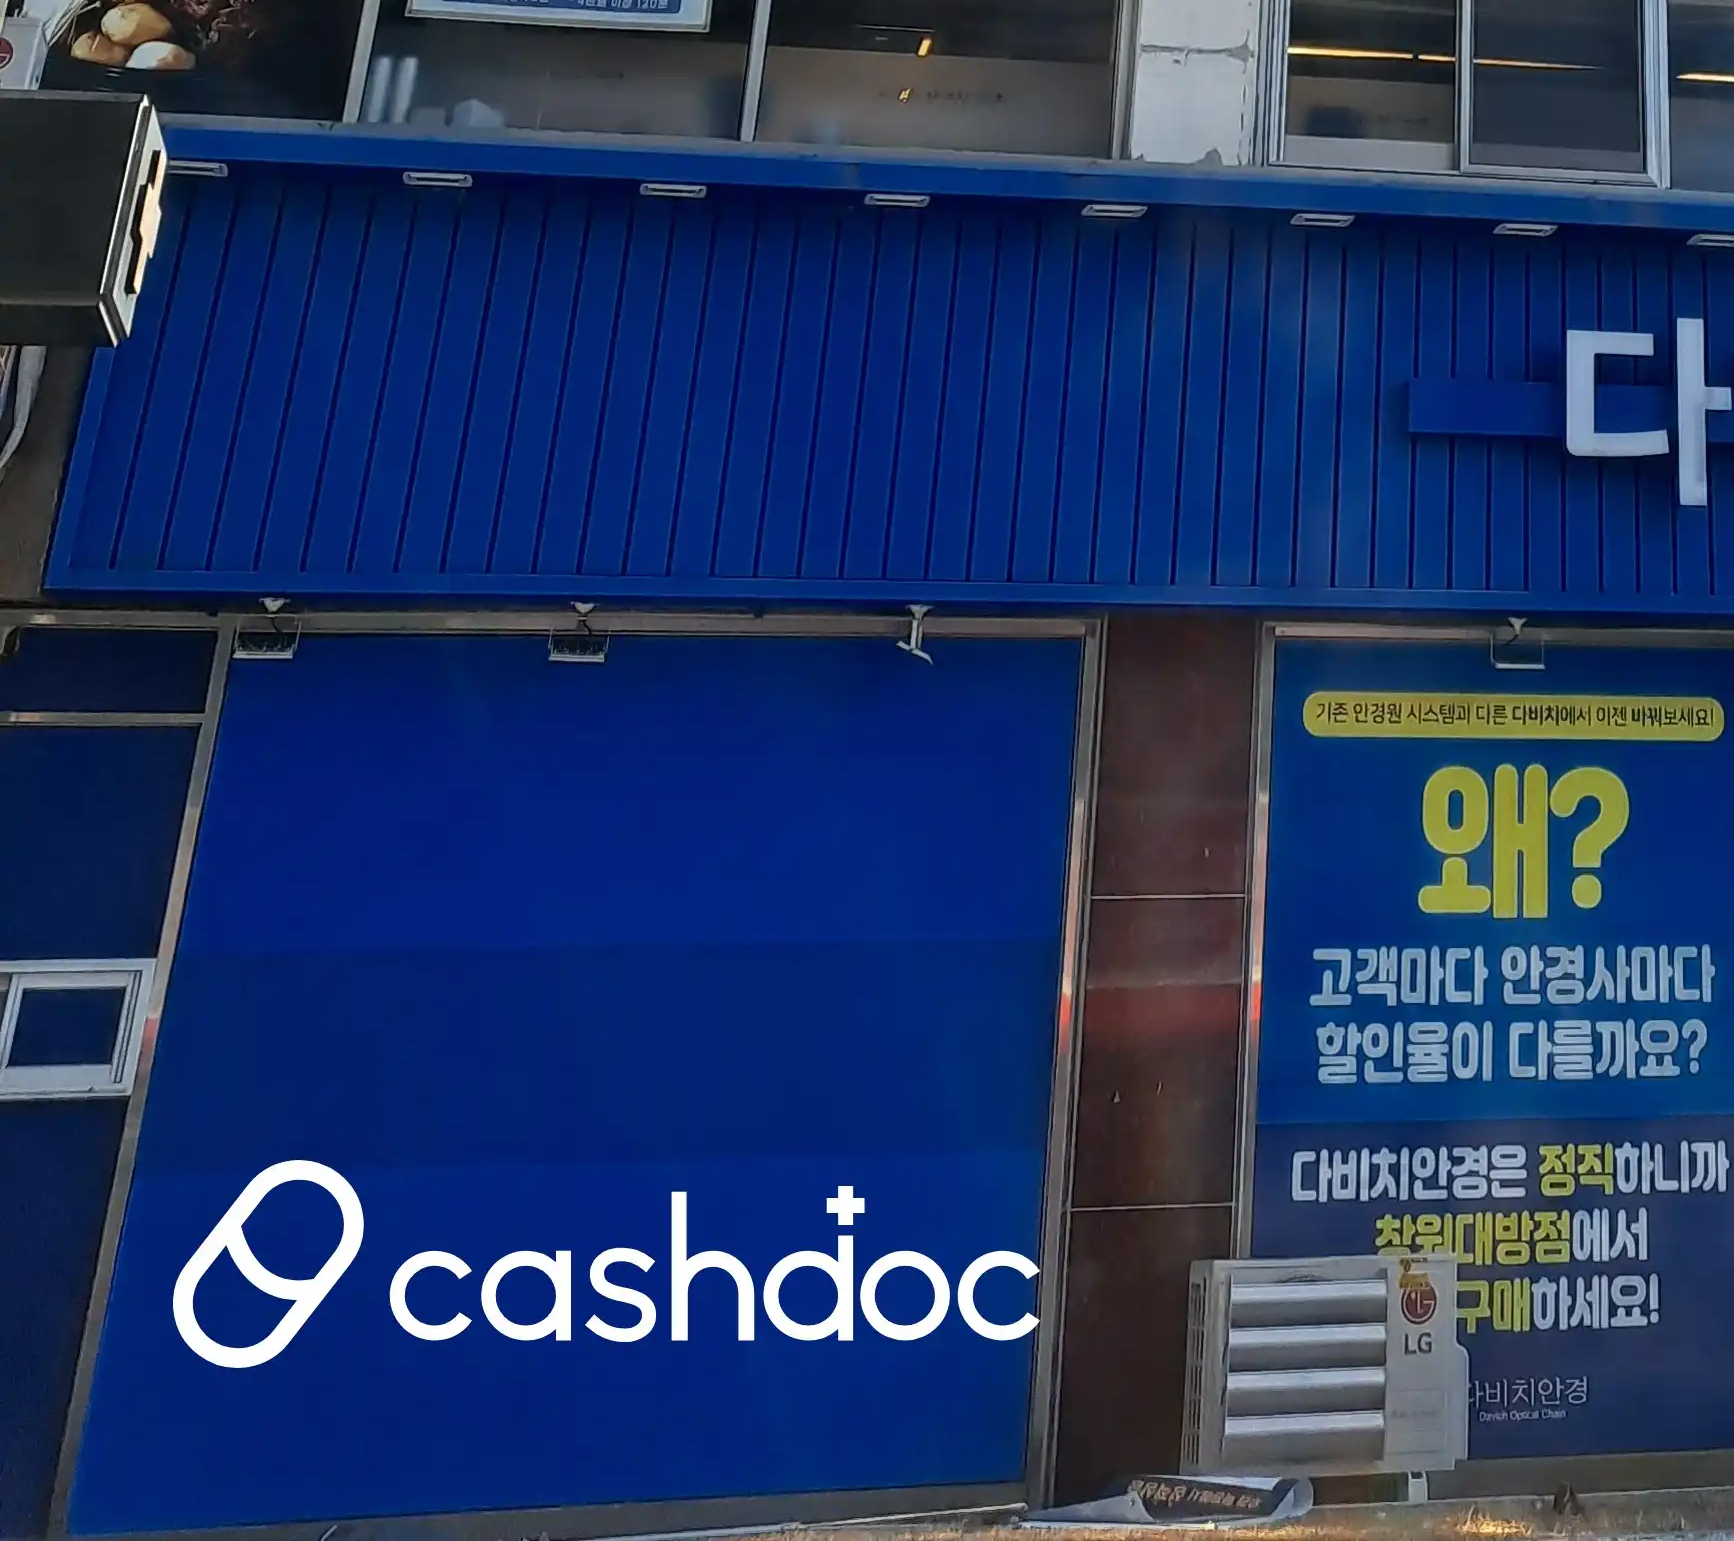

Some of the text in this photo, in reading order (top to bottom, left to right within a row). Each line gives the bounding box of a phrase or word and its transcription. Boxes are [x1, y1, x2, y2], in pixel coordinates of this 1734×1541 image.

[1316, 702, 1349, 725] 기존
[1352, 702, 1402, 725] 안경원
[1476, 703, 1508, 726] 다른
[1512, 703, 1591, 727] 다비치에서
[1596, 705, 1627, 727] 이젠
[1418, 764, 1630, 919] 왜?
[1309, 944, 1715, 1007] 고객마다 안경사마다
[1316, 1018, 1708, 1084] 할인율이 다를까요?
[1291, 1140, 1730, 1203] 다비치안경은 정직하니까
[1456, 1273, 1661, 1334] 구매하세요!
[1404, 1332, 1432, 1355] LG
